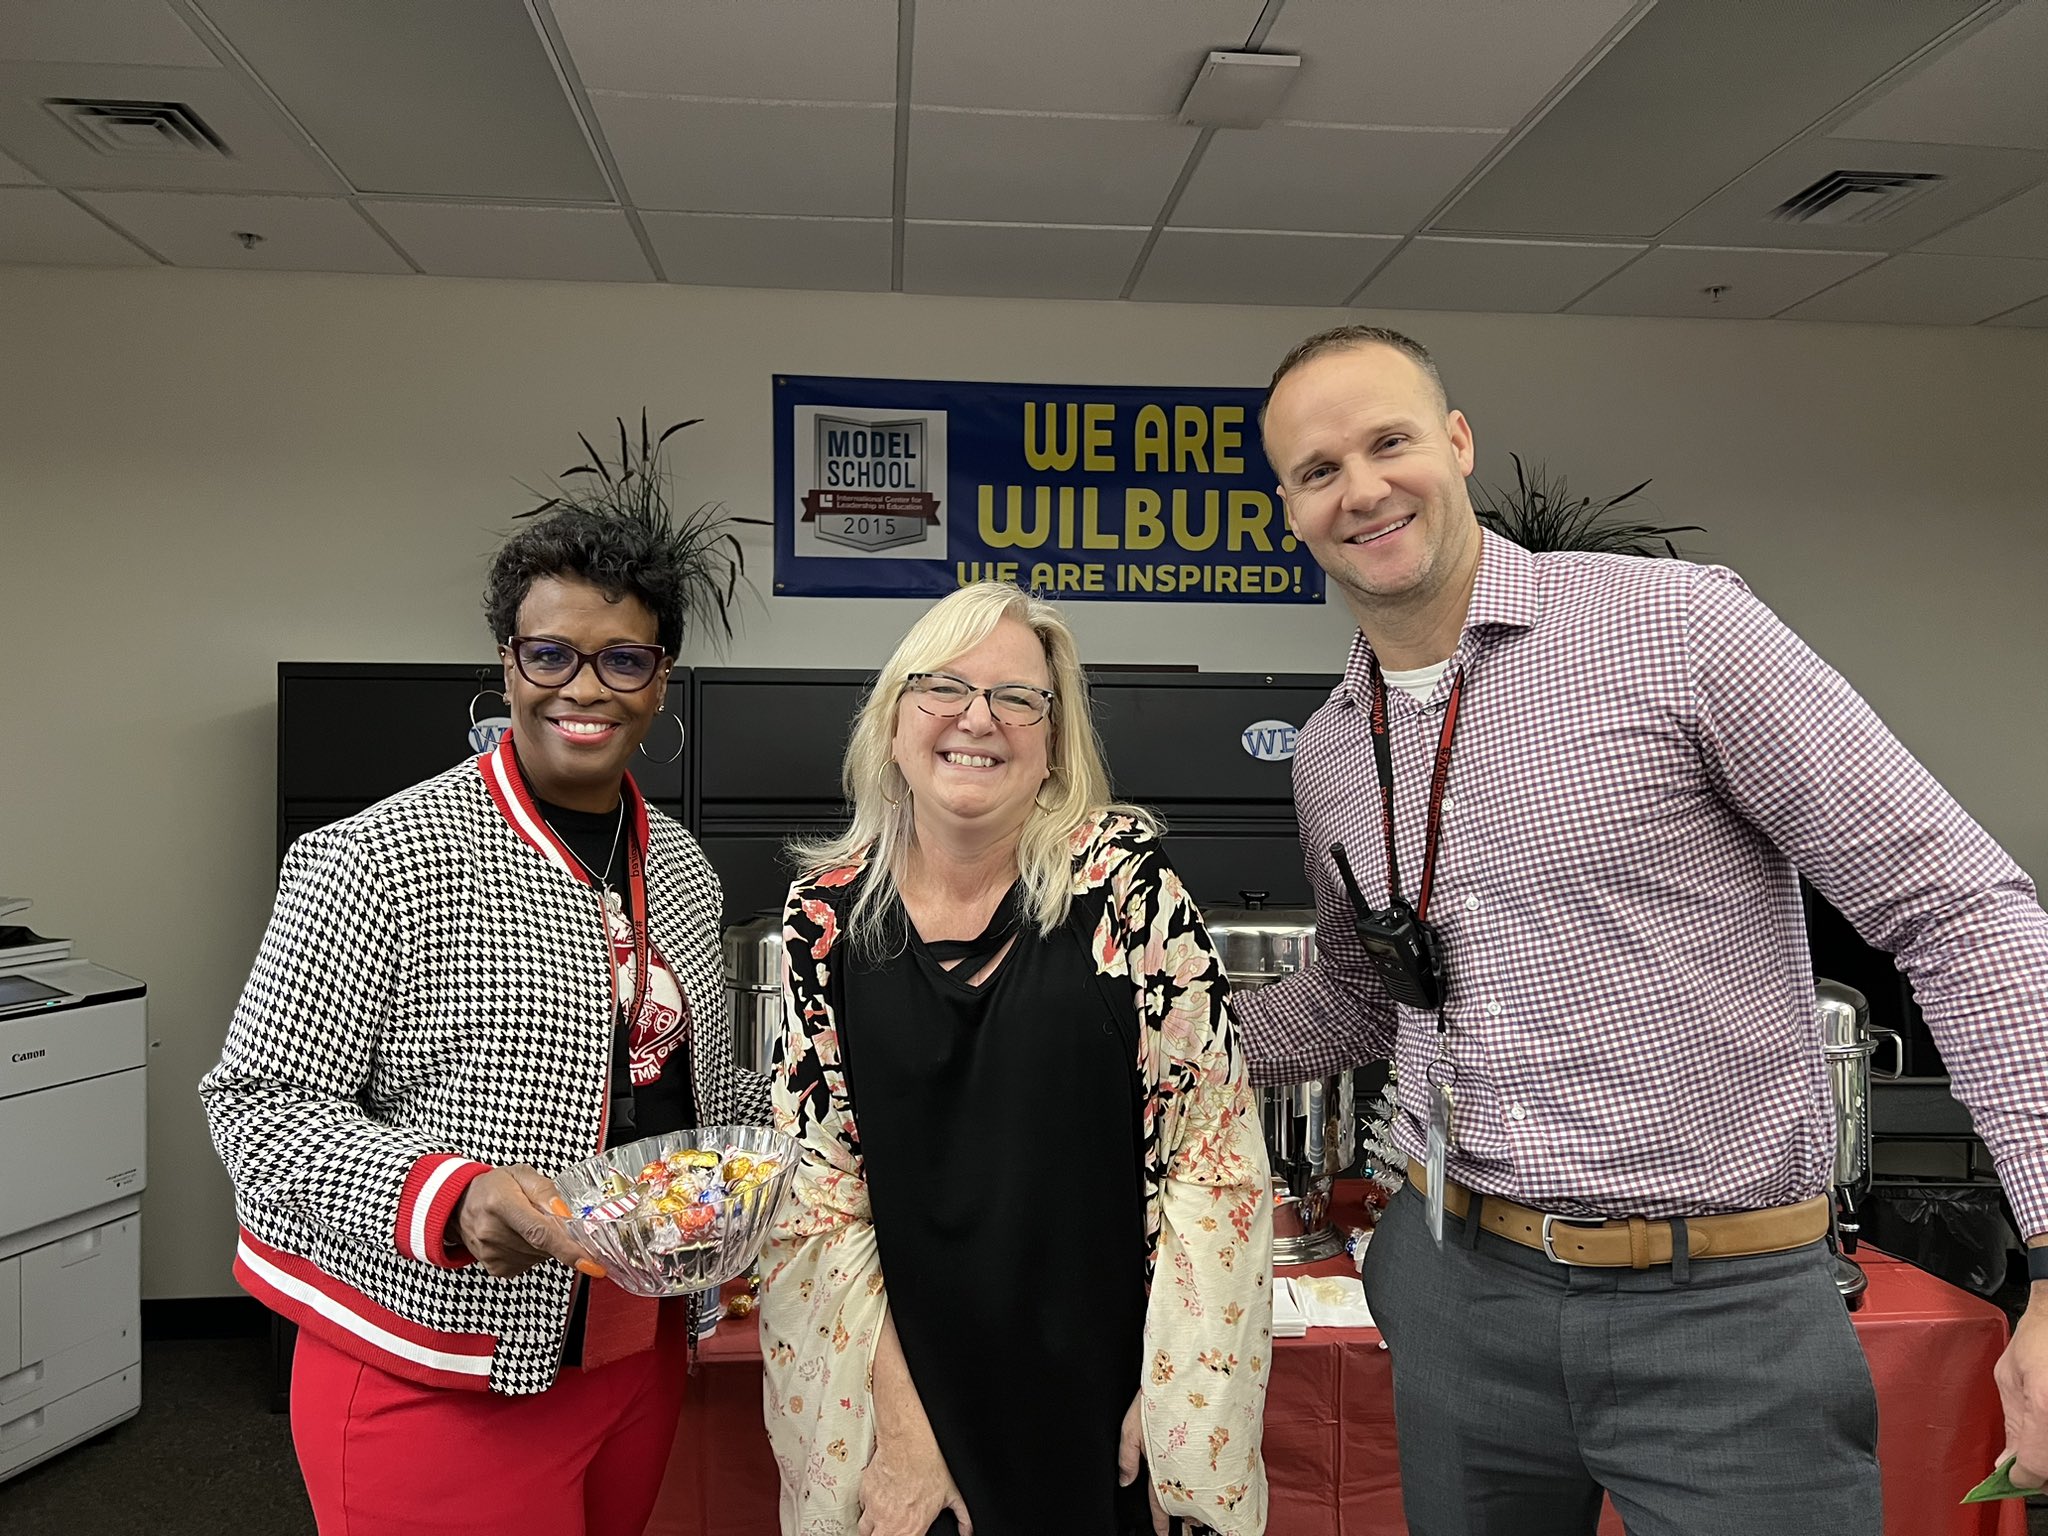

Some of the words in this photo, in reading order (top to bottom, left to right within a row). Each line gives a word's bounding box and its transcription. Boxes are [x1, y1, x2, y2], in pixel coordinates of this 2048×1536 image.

[828, 430, 916, 459] MODEL
[1024, 402, 1115, 472] WE
[1134, 404, 1245, 474] ARE
[827, 460, 916, 488] SCHOOL
[836, 494, 883, 503] International
[884, 495, 910, 504] Center
[911, 496, 923, 504] for
[836, 501, 878, 511] Leadership
[886, 503, 923, 511] Education
[843, 517, 896, 535] 2015
[977, 484, 1297, 552] WILBUR!
[1030, 563, 1105, 592] ARE
[1117, 564, 1302, 593] INSPIRED!
[1243, 727, 1298, 757] WE
[11, 1049, 46, 1063] Canon
